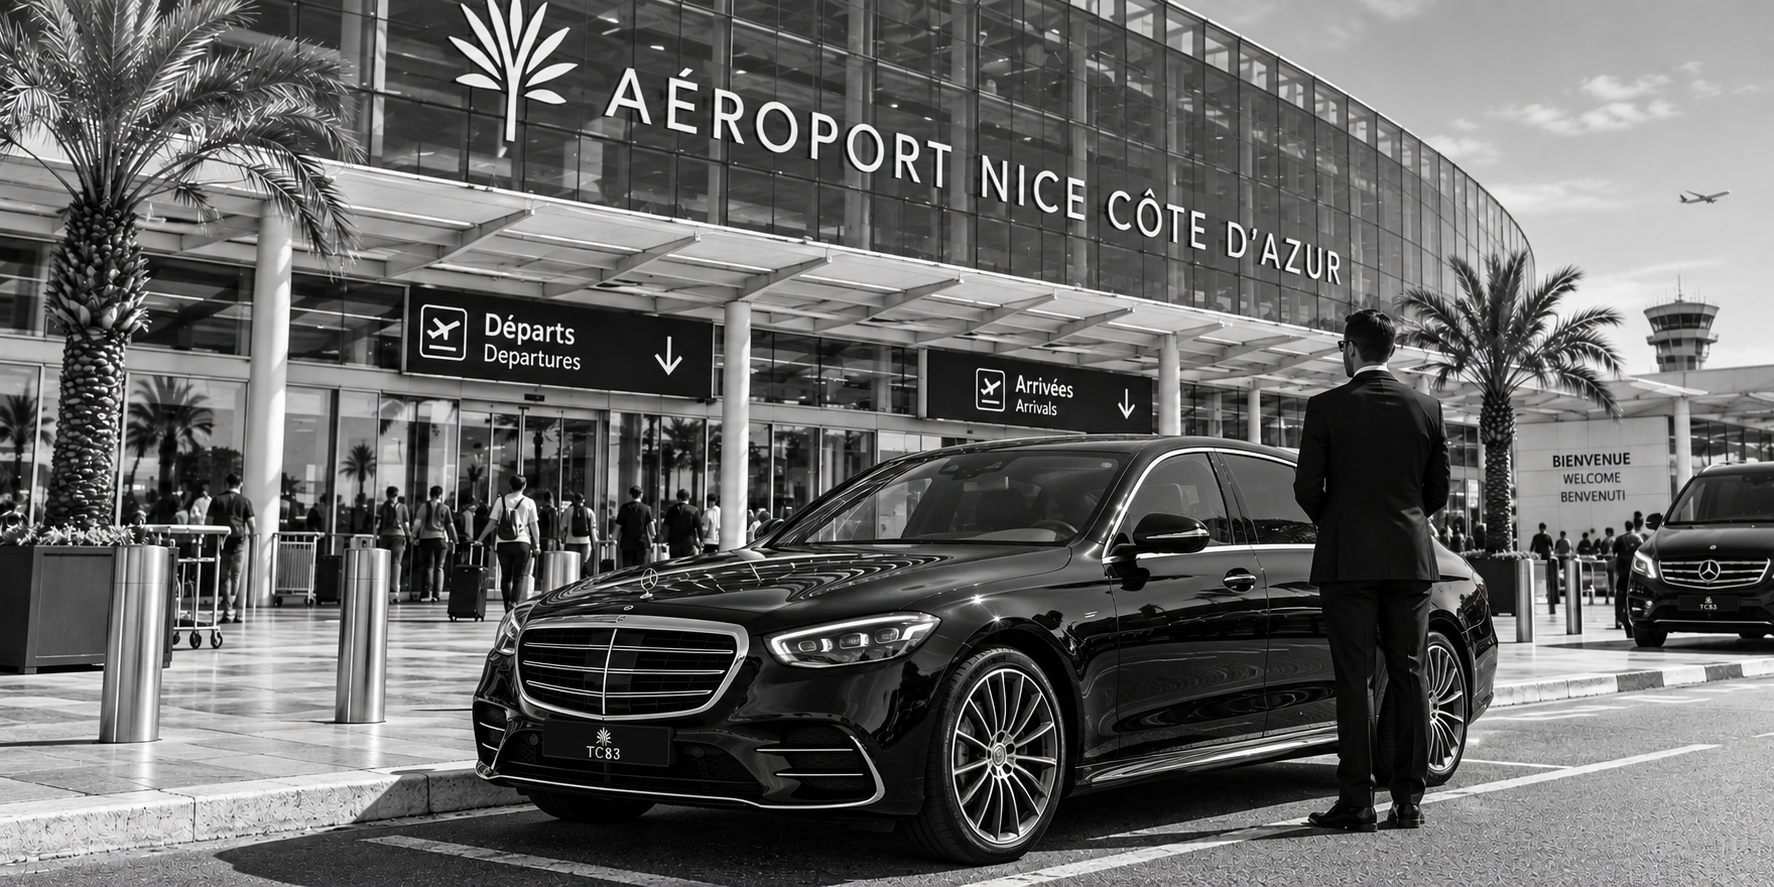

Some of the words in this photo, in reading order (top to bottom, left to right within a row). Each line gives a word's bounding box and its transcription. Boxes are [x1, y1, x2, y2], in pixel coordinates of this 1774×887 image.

[605, 67, 953, 188] AÉROPORT
[981, 155, 1087, 221] NICE
[1107, 188, 1207, 251] CÔTE
[1227, 220, 1342, 286] D’AZUR
[484, 312, 576, 345] Départs
[483, 343, 582, 372] Departures
[1015, 374, 1075, 399] Arrivées
[1015, 398, 1059, 417] Arrivals
[1552, 452, 1631, 468] BIENVENUE
[1562, 472, 1622, 485] WELCOME
[1560, 489, 1626, 503] BENVENUTI
[586, 745, 621, 760] TC83
